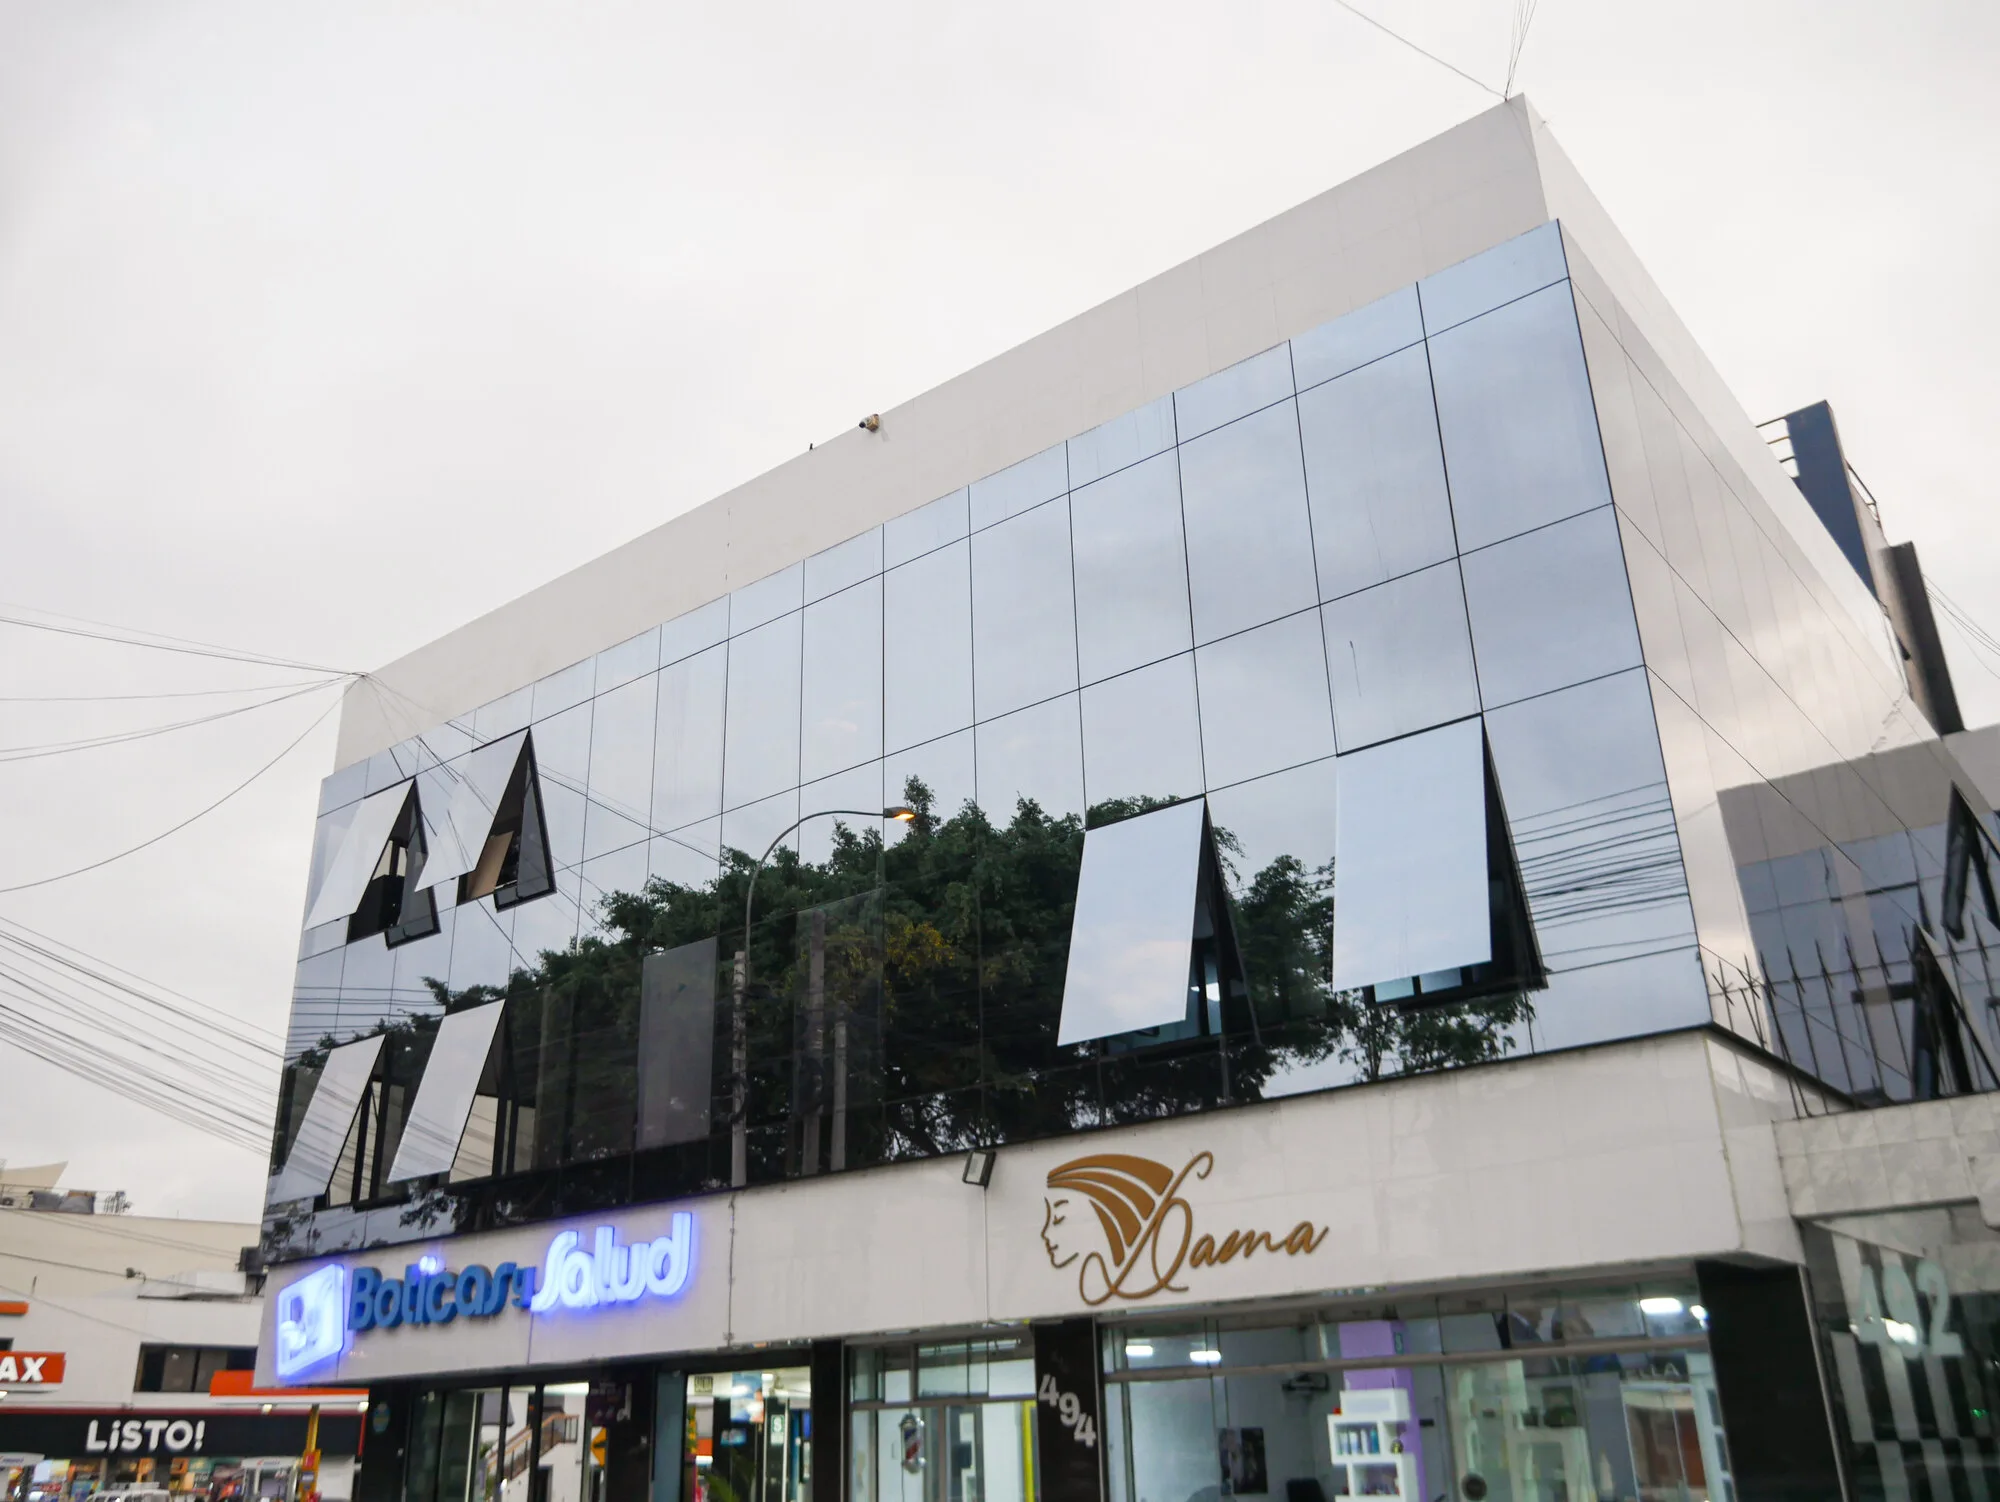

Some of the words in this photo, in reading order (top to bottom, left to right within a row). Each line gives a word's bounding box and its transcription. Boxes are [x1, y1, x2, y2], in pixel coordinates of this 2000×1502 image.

[347, 1257, 516, 1331] Boticas
[530, 1212, 694, 1313] Salud
[1079, 1151, 1329, 1306] Dama
[1038, 1373, 1096, 1449] 494
